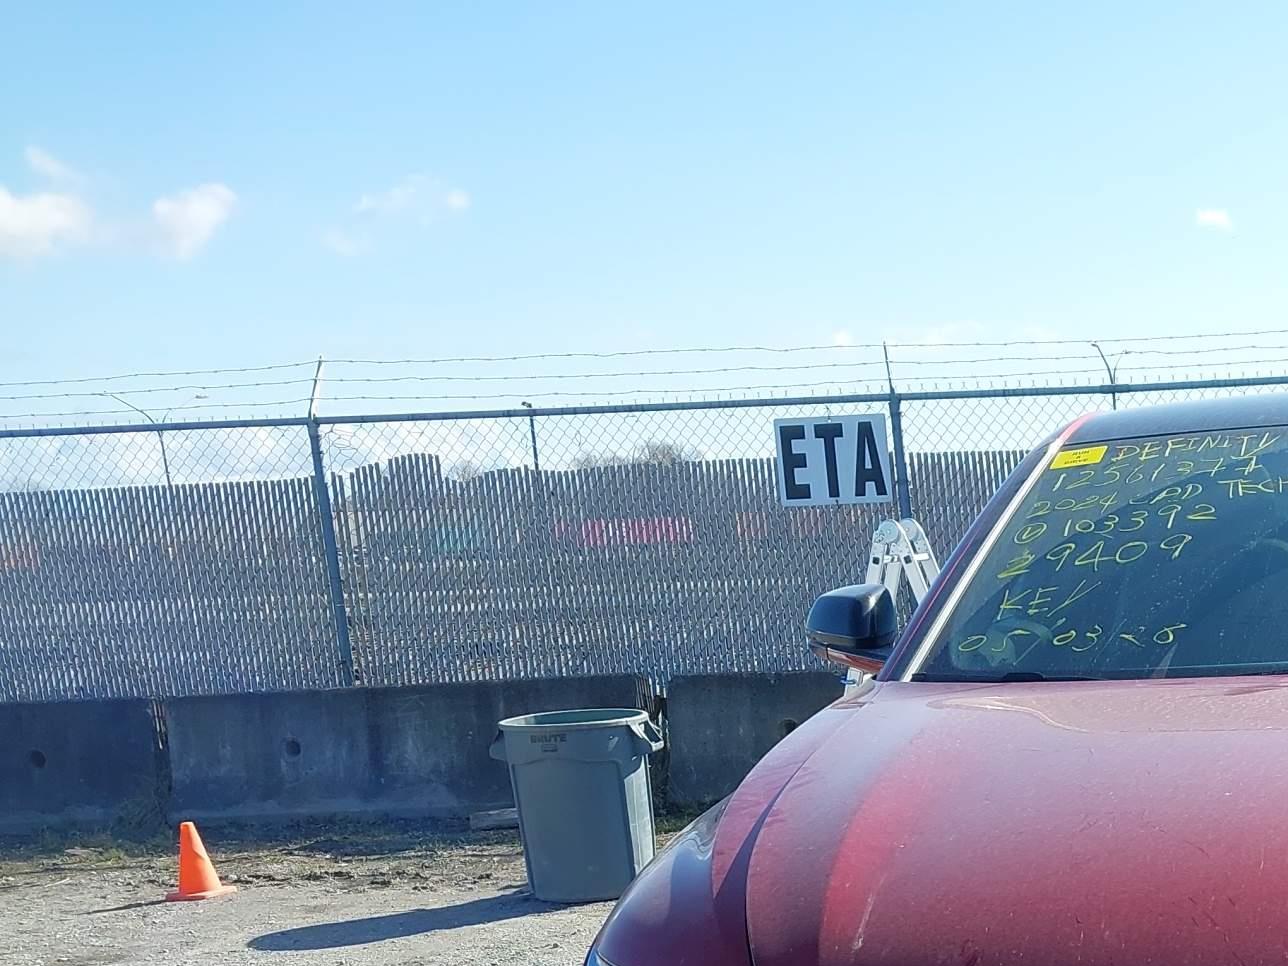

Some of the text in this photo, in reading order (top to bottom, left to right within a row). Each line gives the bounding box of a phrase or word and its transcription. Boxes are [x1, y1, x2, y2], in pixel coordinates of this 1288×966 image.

[779, 421, 888, 500] ETA
[1026, 491, 1118, 518] 2024
[1064, 504, 1217, 537] 103392
